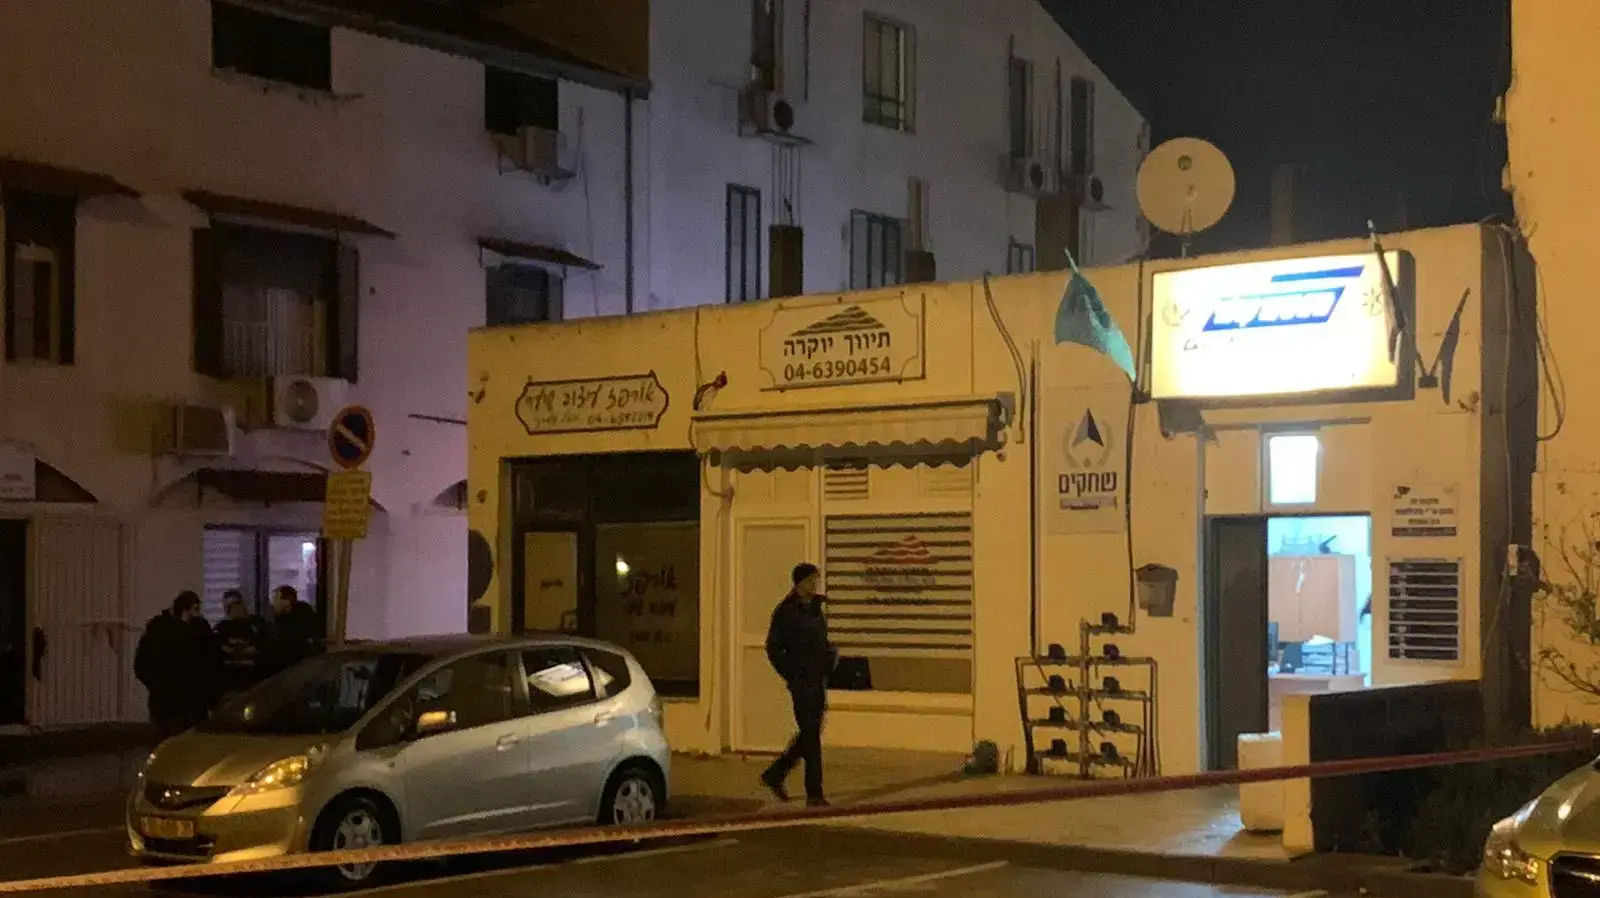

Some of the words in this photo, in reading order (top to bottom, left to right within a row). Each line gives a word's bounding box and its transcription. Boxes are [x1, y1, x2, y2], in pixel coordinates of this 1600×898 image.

[784, 336, 834, 360] יוקרה
[844, 331, 891, 356] תיווך
[783, 355, 891, 382] 04-6390454
[1058, 471, 1118, 498] שחקים
